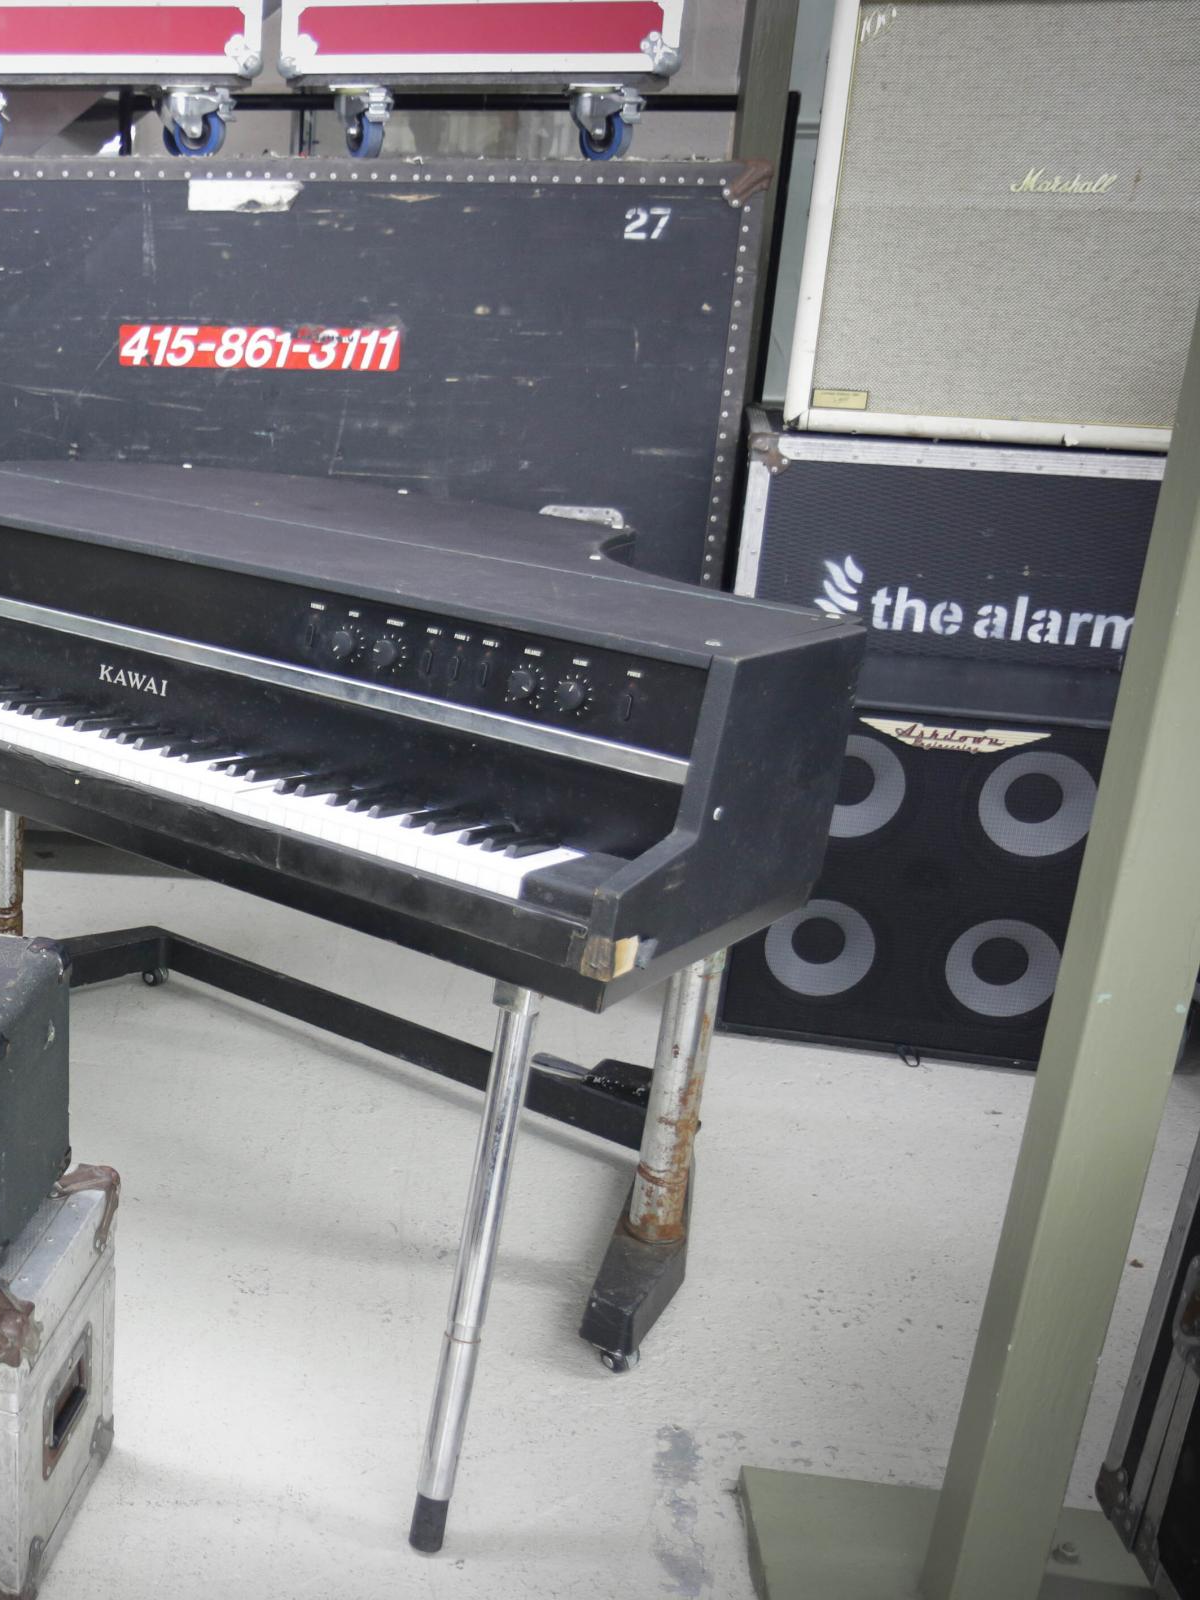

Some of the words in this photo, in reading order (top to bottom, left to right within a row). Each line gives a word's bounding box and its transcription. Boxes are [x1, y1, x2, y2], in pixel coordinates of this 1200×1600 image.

[1010, 167, 1118, 193] Marshall
[623, 207, 671, 240] 27
[120, 327, 398, 369] 415-861-3111
[871, 586, 963, 635] the
[99, 664, 168, 697] KAWAI
[895, 723, 1005, 746] Ashdown
